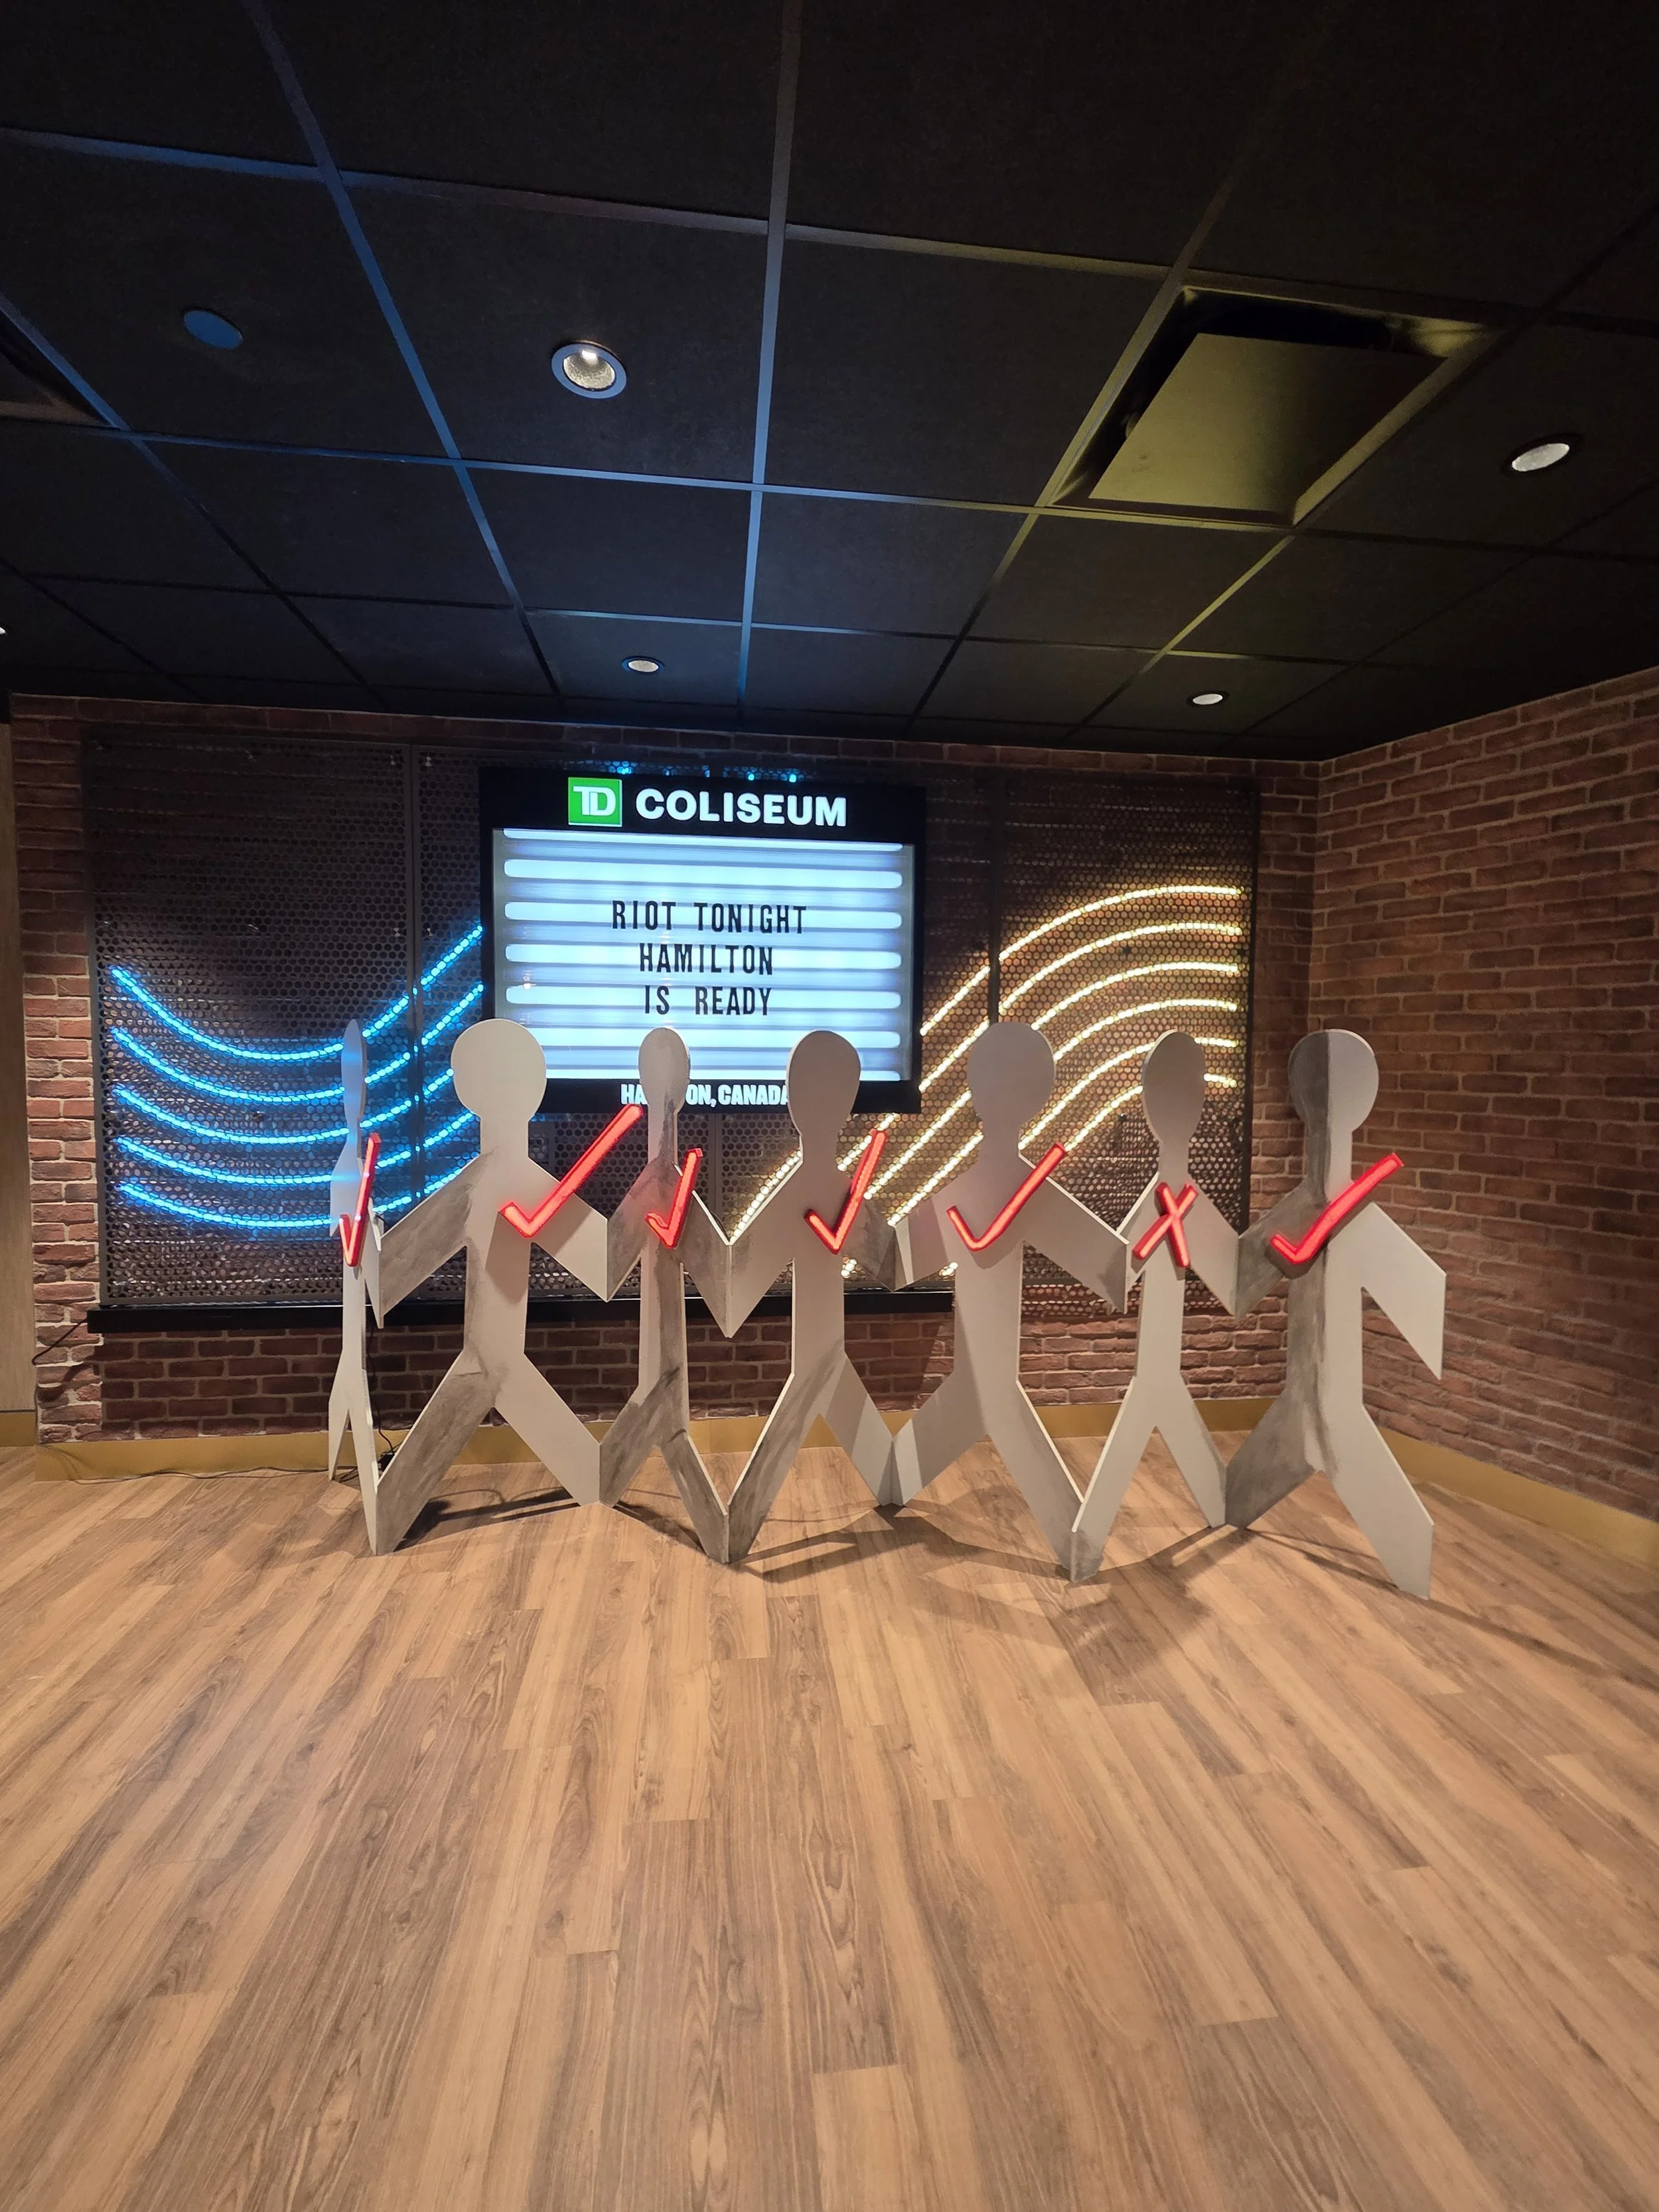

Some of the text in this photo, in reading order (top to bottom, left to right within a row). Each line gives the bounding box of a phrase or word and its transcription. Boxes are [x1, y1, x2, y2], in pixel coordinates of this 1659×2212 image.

[573, 786, 847, 827] TD COLISEUM
[612, 900, 807, 934] RIOT TONIGHT
[639, 942, 773, 976] HAMILTON
[644, 985, 772, 1016] IS READY
[620, 1084, 717, 1108] HAON,
